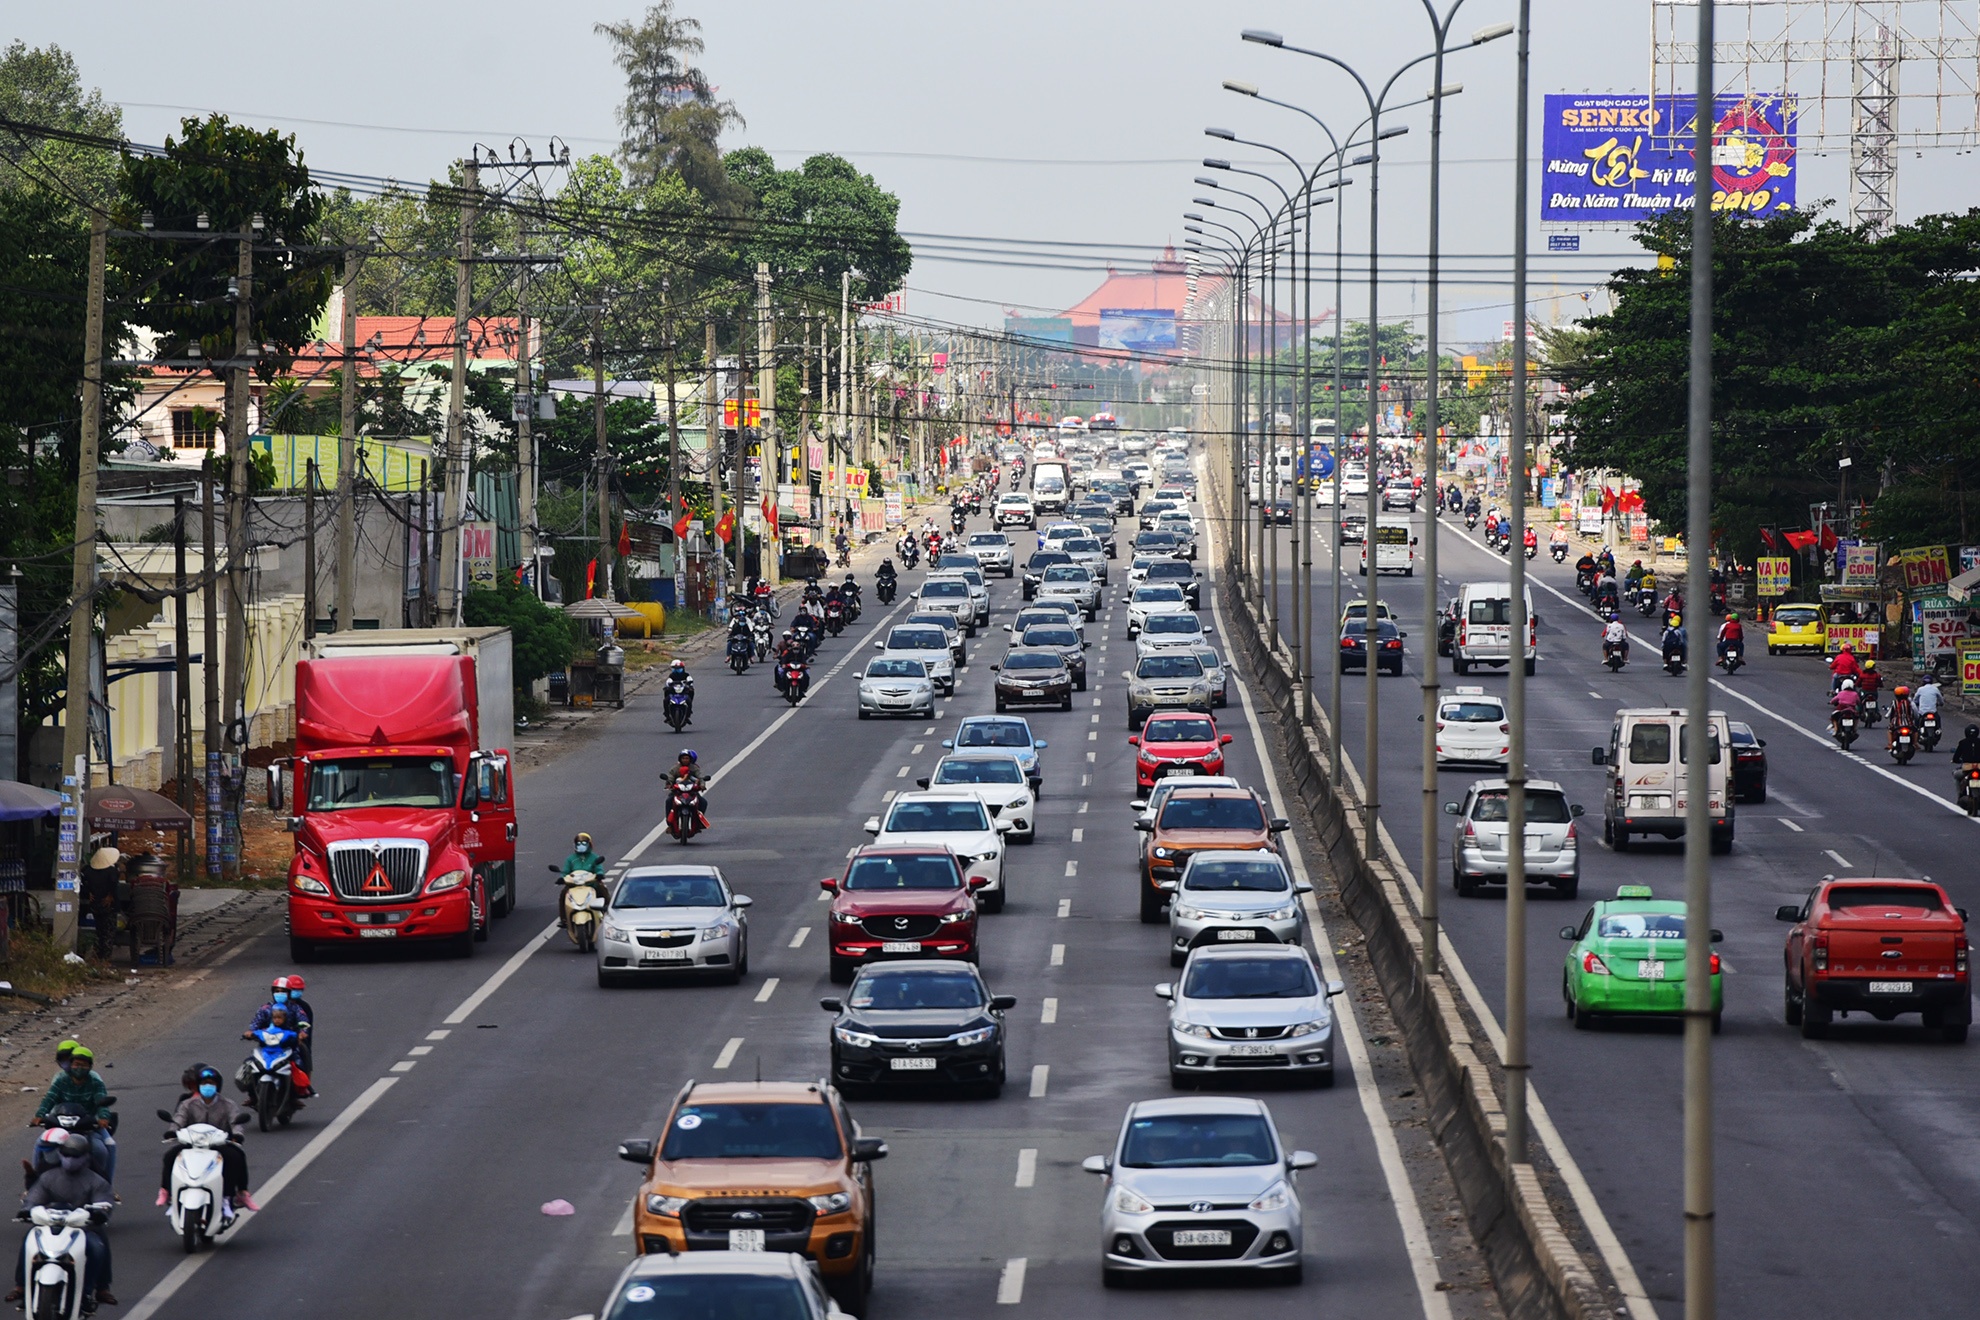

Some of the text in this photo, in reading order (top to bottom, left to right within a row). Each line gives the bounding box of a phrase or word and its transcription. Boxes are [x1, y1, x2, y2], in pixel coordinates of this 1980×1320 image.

[1562, 109, 1661, 127] SENKO
[1548, 160, 1589, 176] Mừng
[1584, 135, 1652, 192] Tết
[1550, 194, 1580, 208] Đón
[1582, 193, 1619, 208] Năm
[1622, 194, 1671, 211] Thuận
[1711, 190, 1771, 212] 2019
[1849, 563, 1875, 575] CƠM
[1905, 556, 1947, 587] CƠM
[1828, 625, 1850, 638] BÁNH
[1929, 618, 1966, 633] SỬA
